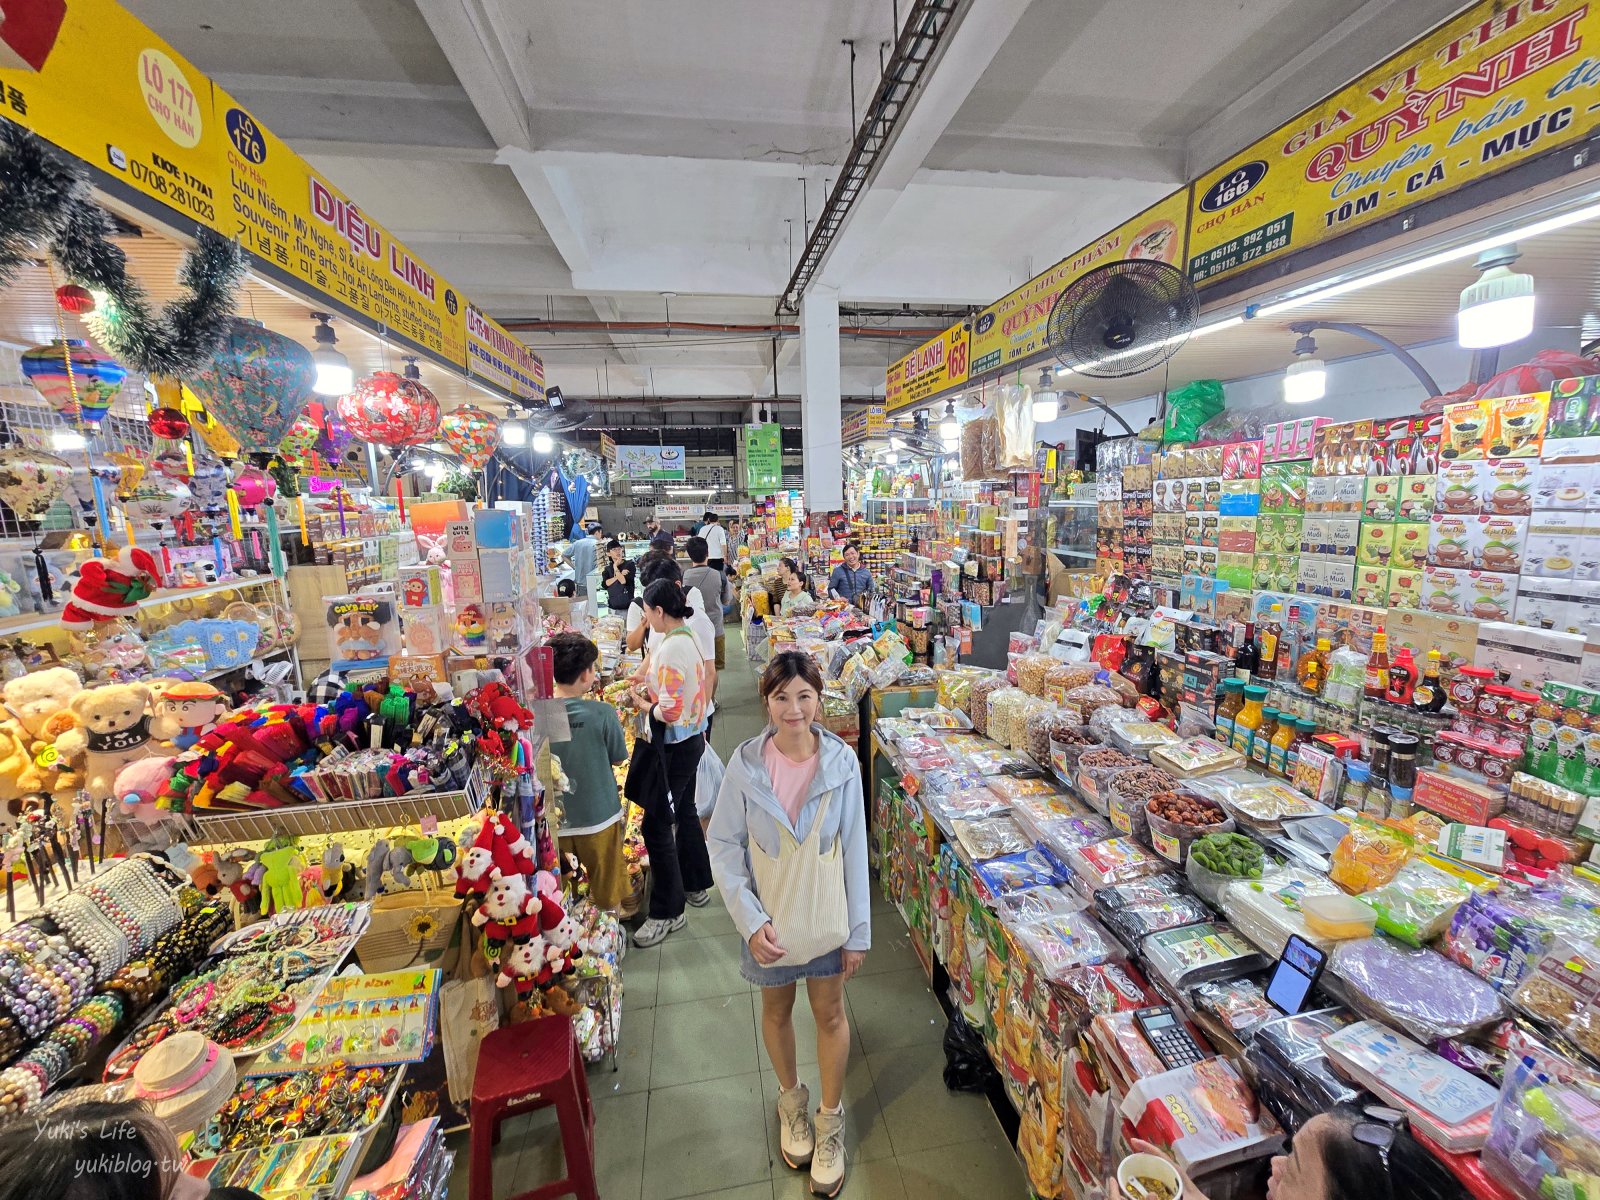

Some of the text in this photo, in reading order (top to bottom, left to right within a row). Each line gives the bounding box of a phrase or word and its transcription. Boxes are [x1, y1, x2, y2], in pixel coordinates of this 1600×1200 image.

[168, 78, 193, 117] 177
[1281, 108, 1356, 157] GIA
[1368, 60, 1426, 104] VỊ
[1305, 3, 1590, 183] QUỲNH
[239, 114, 253, 136] LÔ
[1330, 92, 1527, 200] Chuyên bán
[233, 128, 260, 165] 176
[1325, 190, 1380, 228] TÔM
[1406, 158, 1444, 194] CÁ
[1481, 106, 1574, 164] MỰC
[130, 160, 215, 222] 0708 281023
[1214, 178, 1251, 208] 166
[1218, 170, 1247, 194] LÔ
[233, 194, 290, 244] Souvenir
[1197, 191, 1267, 235] CHỢ HÀN
[309, 175, 436, 304] DIỆU LINH
[1209, 257, 1239, 276] 05113.
[1242, 246, 1262, 262] 872
[1265, 234, 1287, 252] 938
[1210, 241, 1241, 261] 05113.
[1243, 229, 1264, 248] 892
[1266, 219, 1287, 237] 051
[998, 300, 1017, 315] GIA
[1035, 266, 1070, 294] THỰC
[1072, 235, 1123, 273] PHẨM
[1001, 288, 1062, 338] QUỲNH
[951, 327, 962, 344] Lot
[904, 348, 916, 380] BÉ
[917, 338, 944, 374] LANH
[947, 341, 966, 381] 168
[99, 735, 143, 751] YOU
